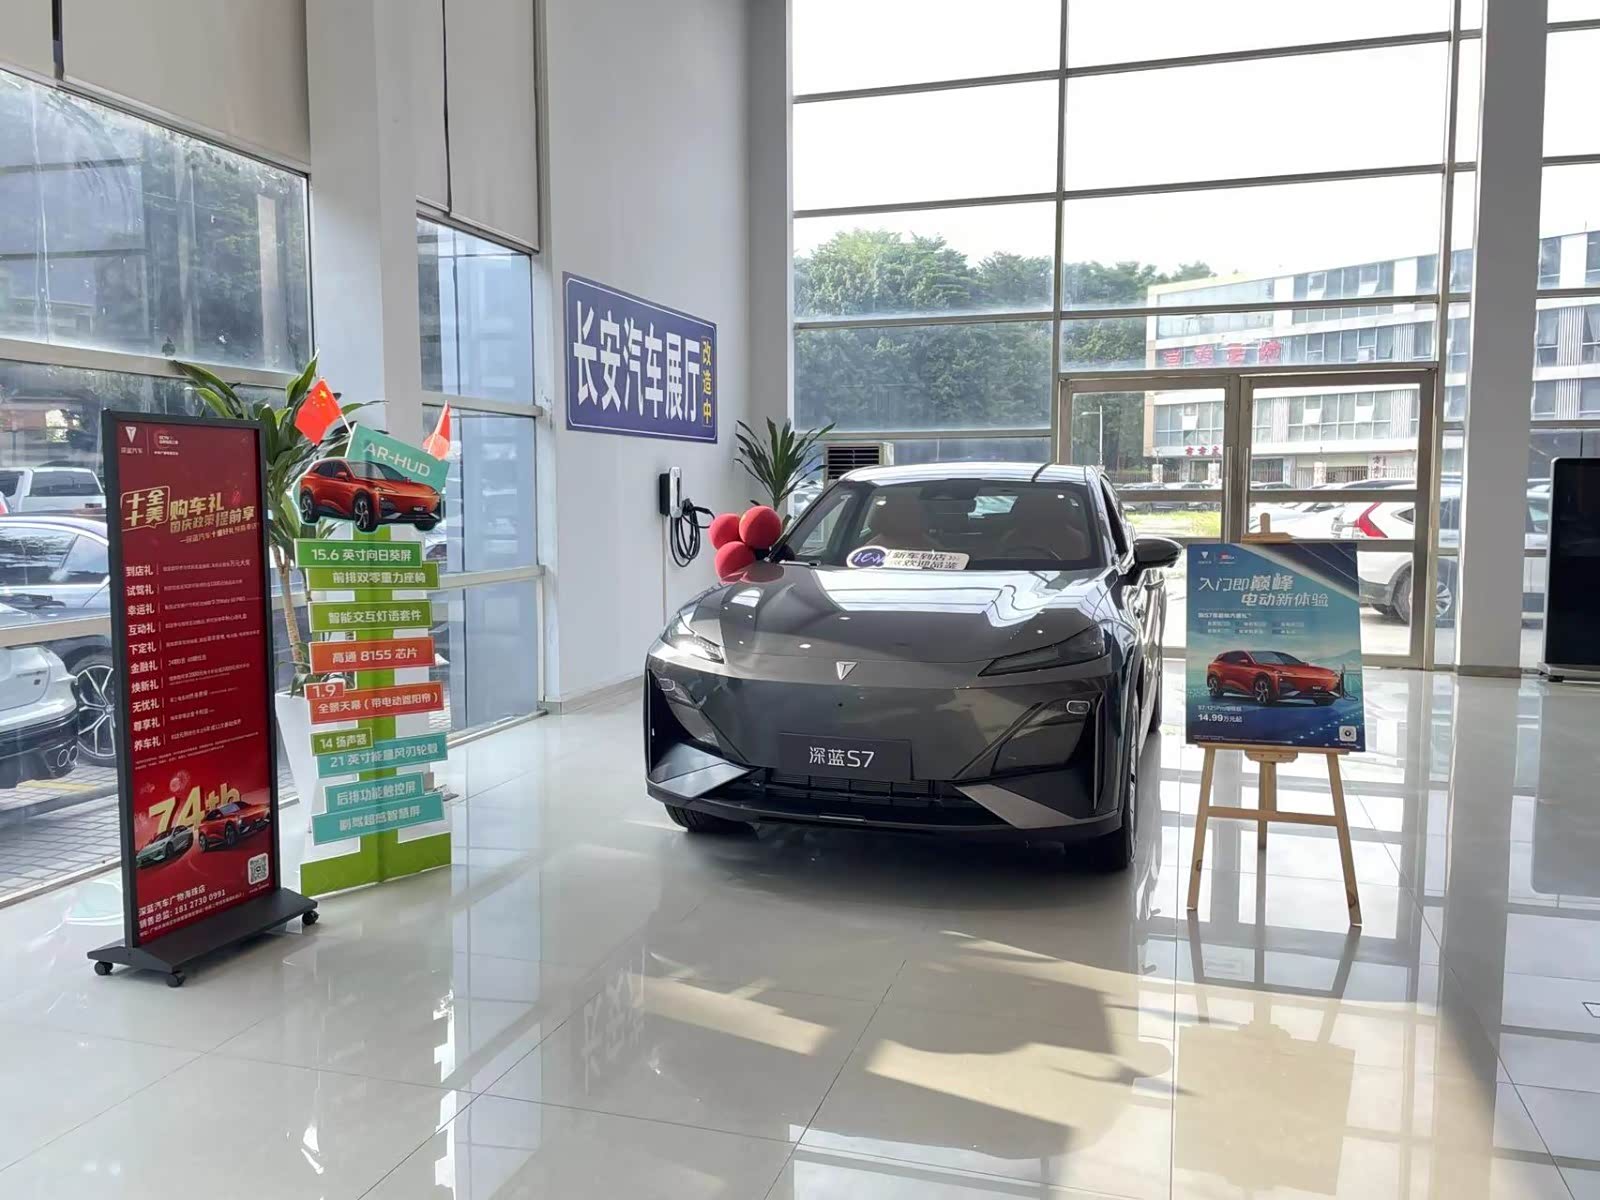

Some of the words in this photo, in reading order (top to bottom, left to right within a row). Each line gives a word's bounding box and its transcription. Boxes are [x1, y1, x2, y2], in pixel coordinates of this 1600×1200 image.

[573, 300, 700, 423] 长安汽车展厅
[702, 340, 712, 424] 改造中
[363, 442, 431, 477] AR-HUD
[170, 492, 224, 521] 购车礼
[170, 506, 255, 533] 国庆政策提前享
[311, 549, 339, 561] 15.6
[342, 549, 412, 562] 英寸向日葵屏
[125, 565, 153, 577] 到店礼
[332, 572, 426, 584] 前排双零重力座椅
[1198, 572, 1295, 592] 入门即巅峰
[126, 584, 154, 597] 试驾礼
[1241, 592, 1329, 608] 电动新体验
[127, 603, 155, 616] 幸运礼
[328, 609, 422, 625] 智能交互灯语套件
[128, 622, 155, 637] 互动礼
[128, 641, 157, 656] 下定礼
[332, 651, 357, 664] 高通
[360, 649, 392, 662] 8155
[395, 647, 418, 659] 芯片
[130, 660, 158, 675] 金融礼
[131, 679, 159, 694] 焕新礼
[312, 684, 337, 698] 1.9
[132, 698, 160, 713] 无忧礼
[133, 717, 160, 732] 尊享礼
[134, 736, 162, 752] 养车礼
[320, 738, 333, 749] 14
[336, 733, 367, 748] 扬声器
[330, 756, 345, 768] 21
[347, 743, 438, 766] 英寸能量风刃轮毂
[809, 746, 875, 768] 深蓝S7
[337, 780, 416, 806] 后排功能触控屏
[149, 782, 241, 835] 74th
[174, 903, 188, 915] 181
[189, 896, 208, 909] 2730
[208, 888, 226, 901] 0991
